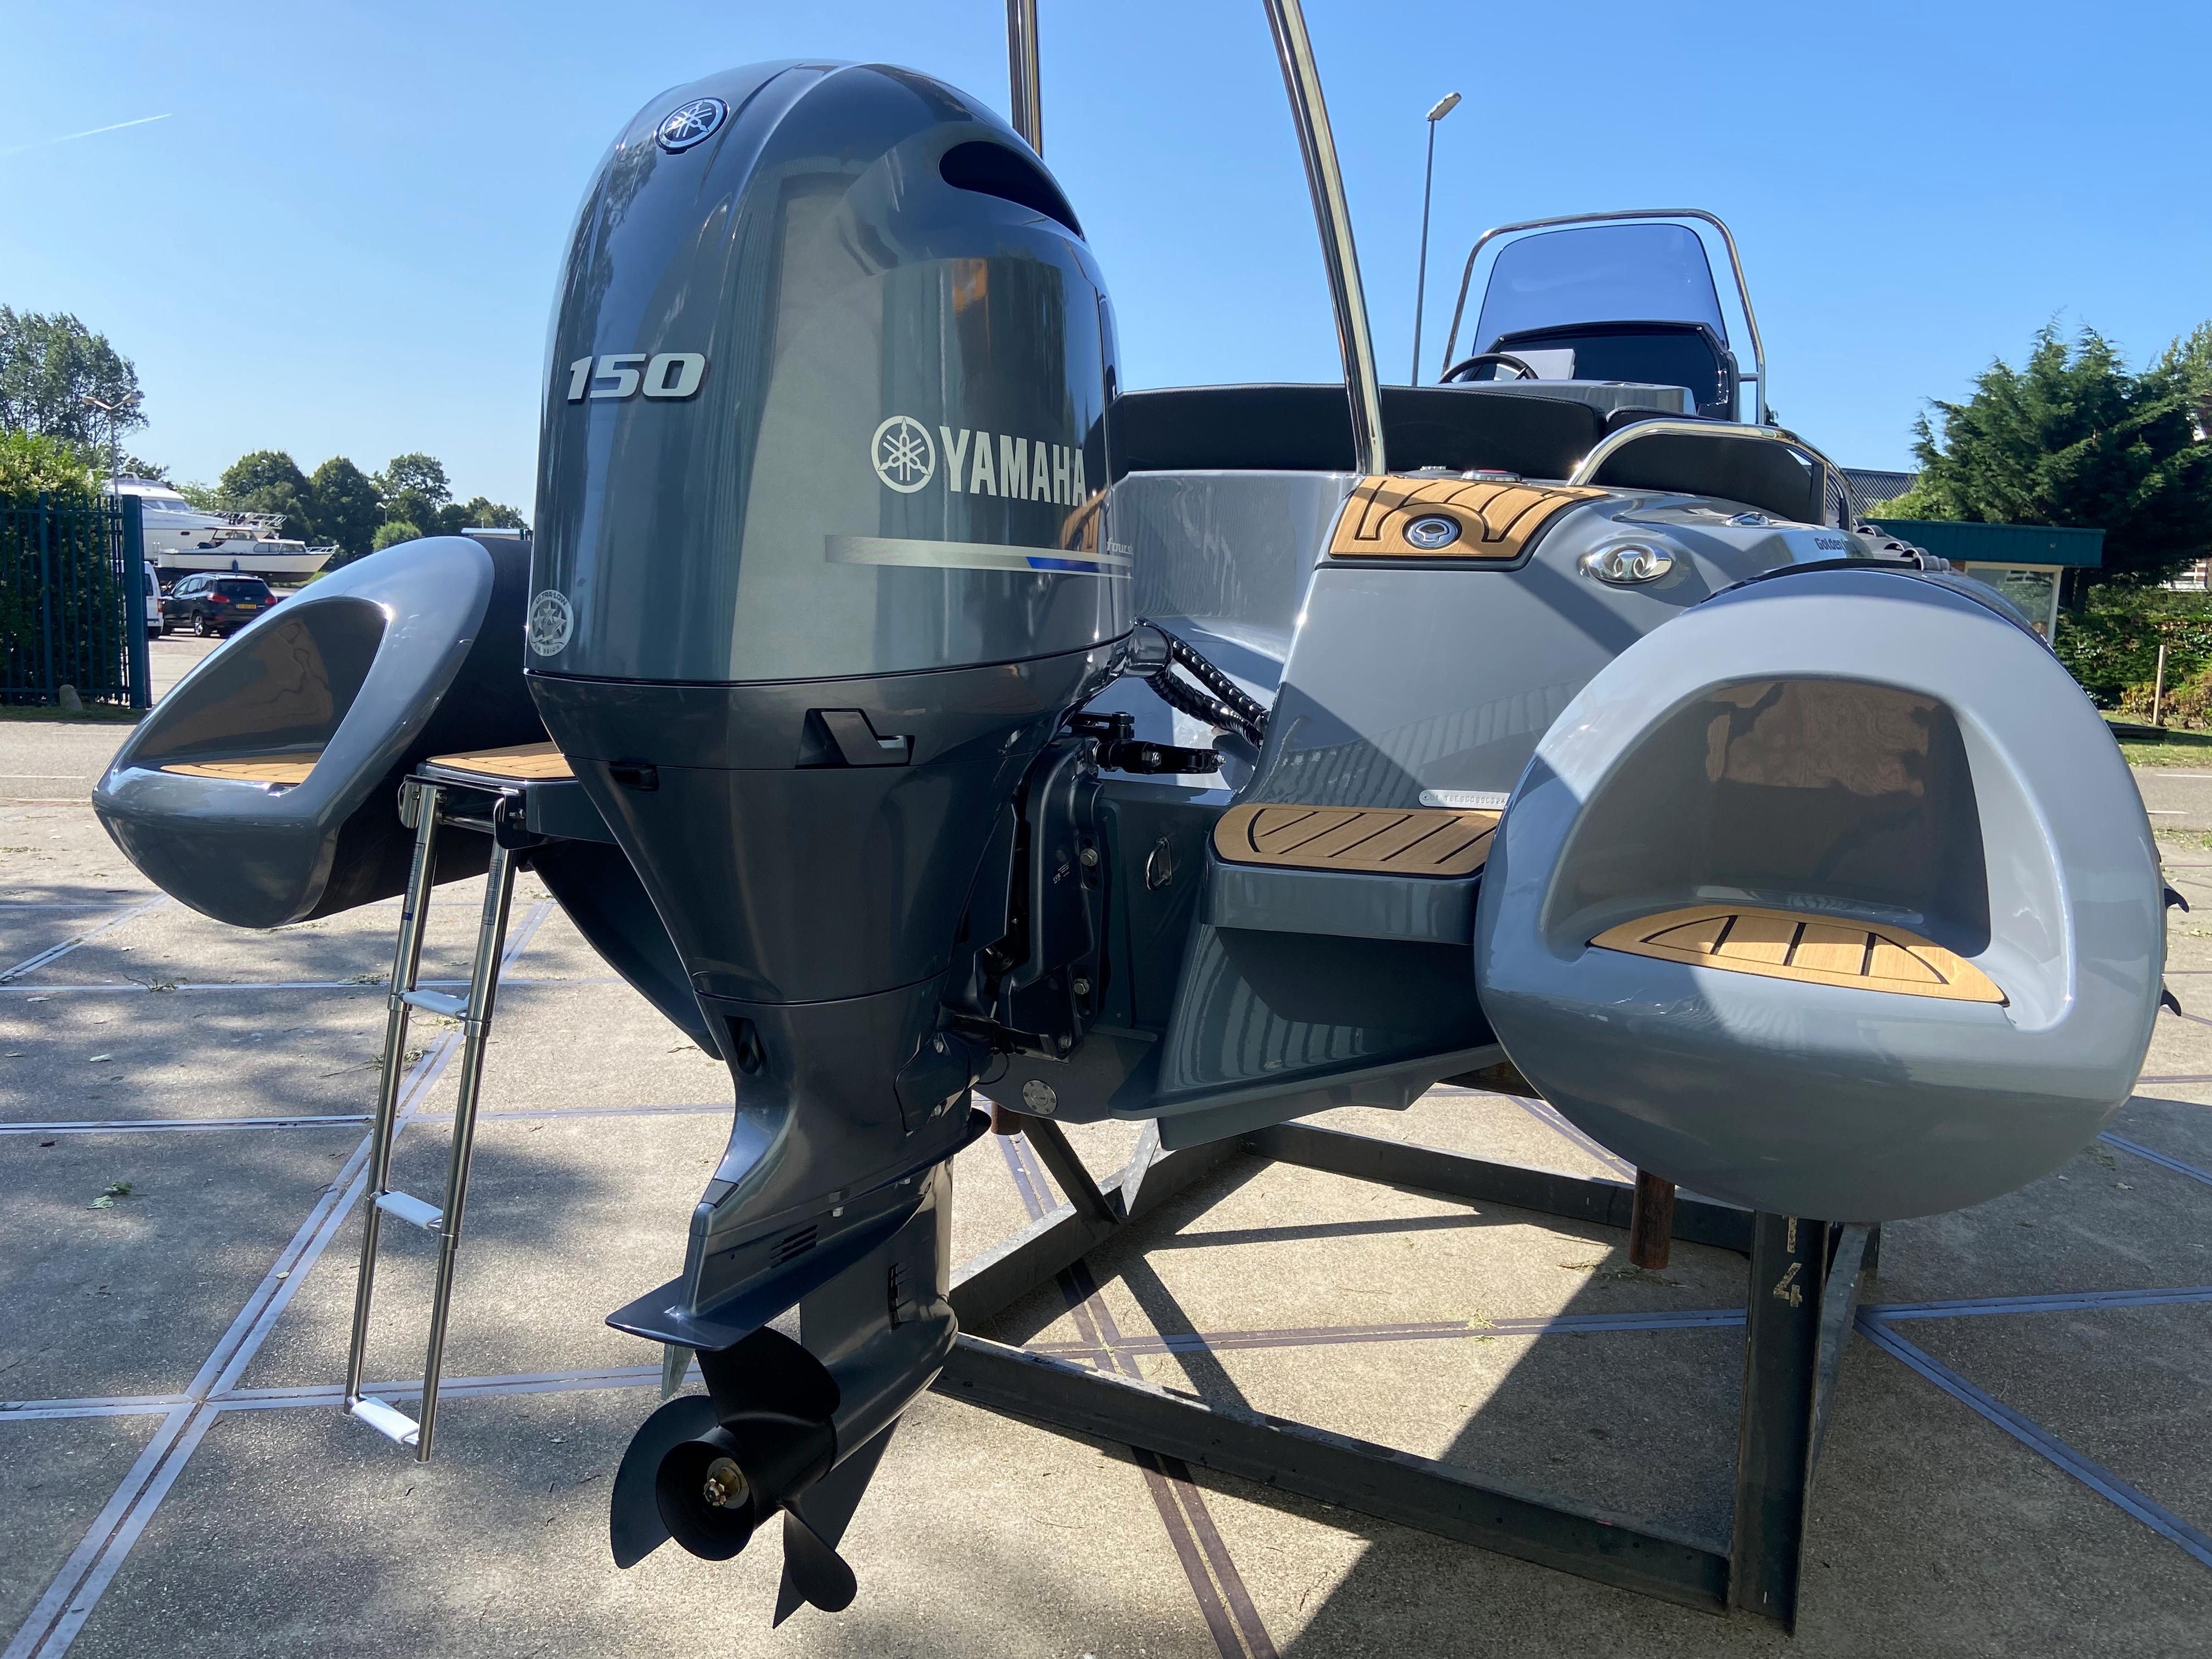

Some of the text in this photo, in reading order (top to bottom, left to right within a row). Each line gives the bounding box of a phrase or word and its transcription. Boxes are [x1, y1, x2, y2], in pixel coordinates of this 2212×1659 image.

[567, 353, 706, 400] 150
[939, 426, 1087, 507] YAMAHA
[1814, 538, 1846, 550] Golden
[535, 644, 560, 653] EMSSION
